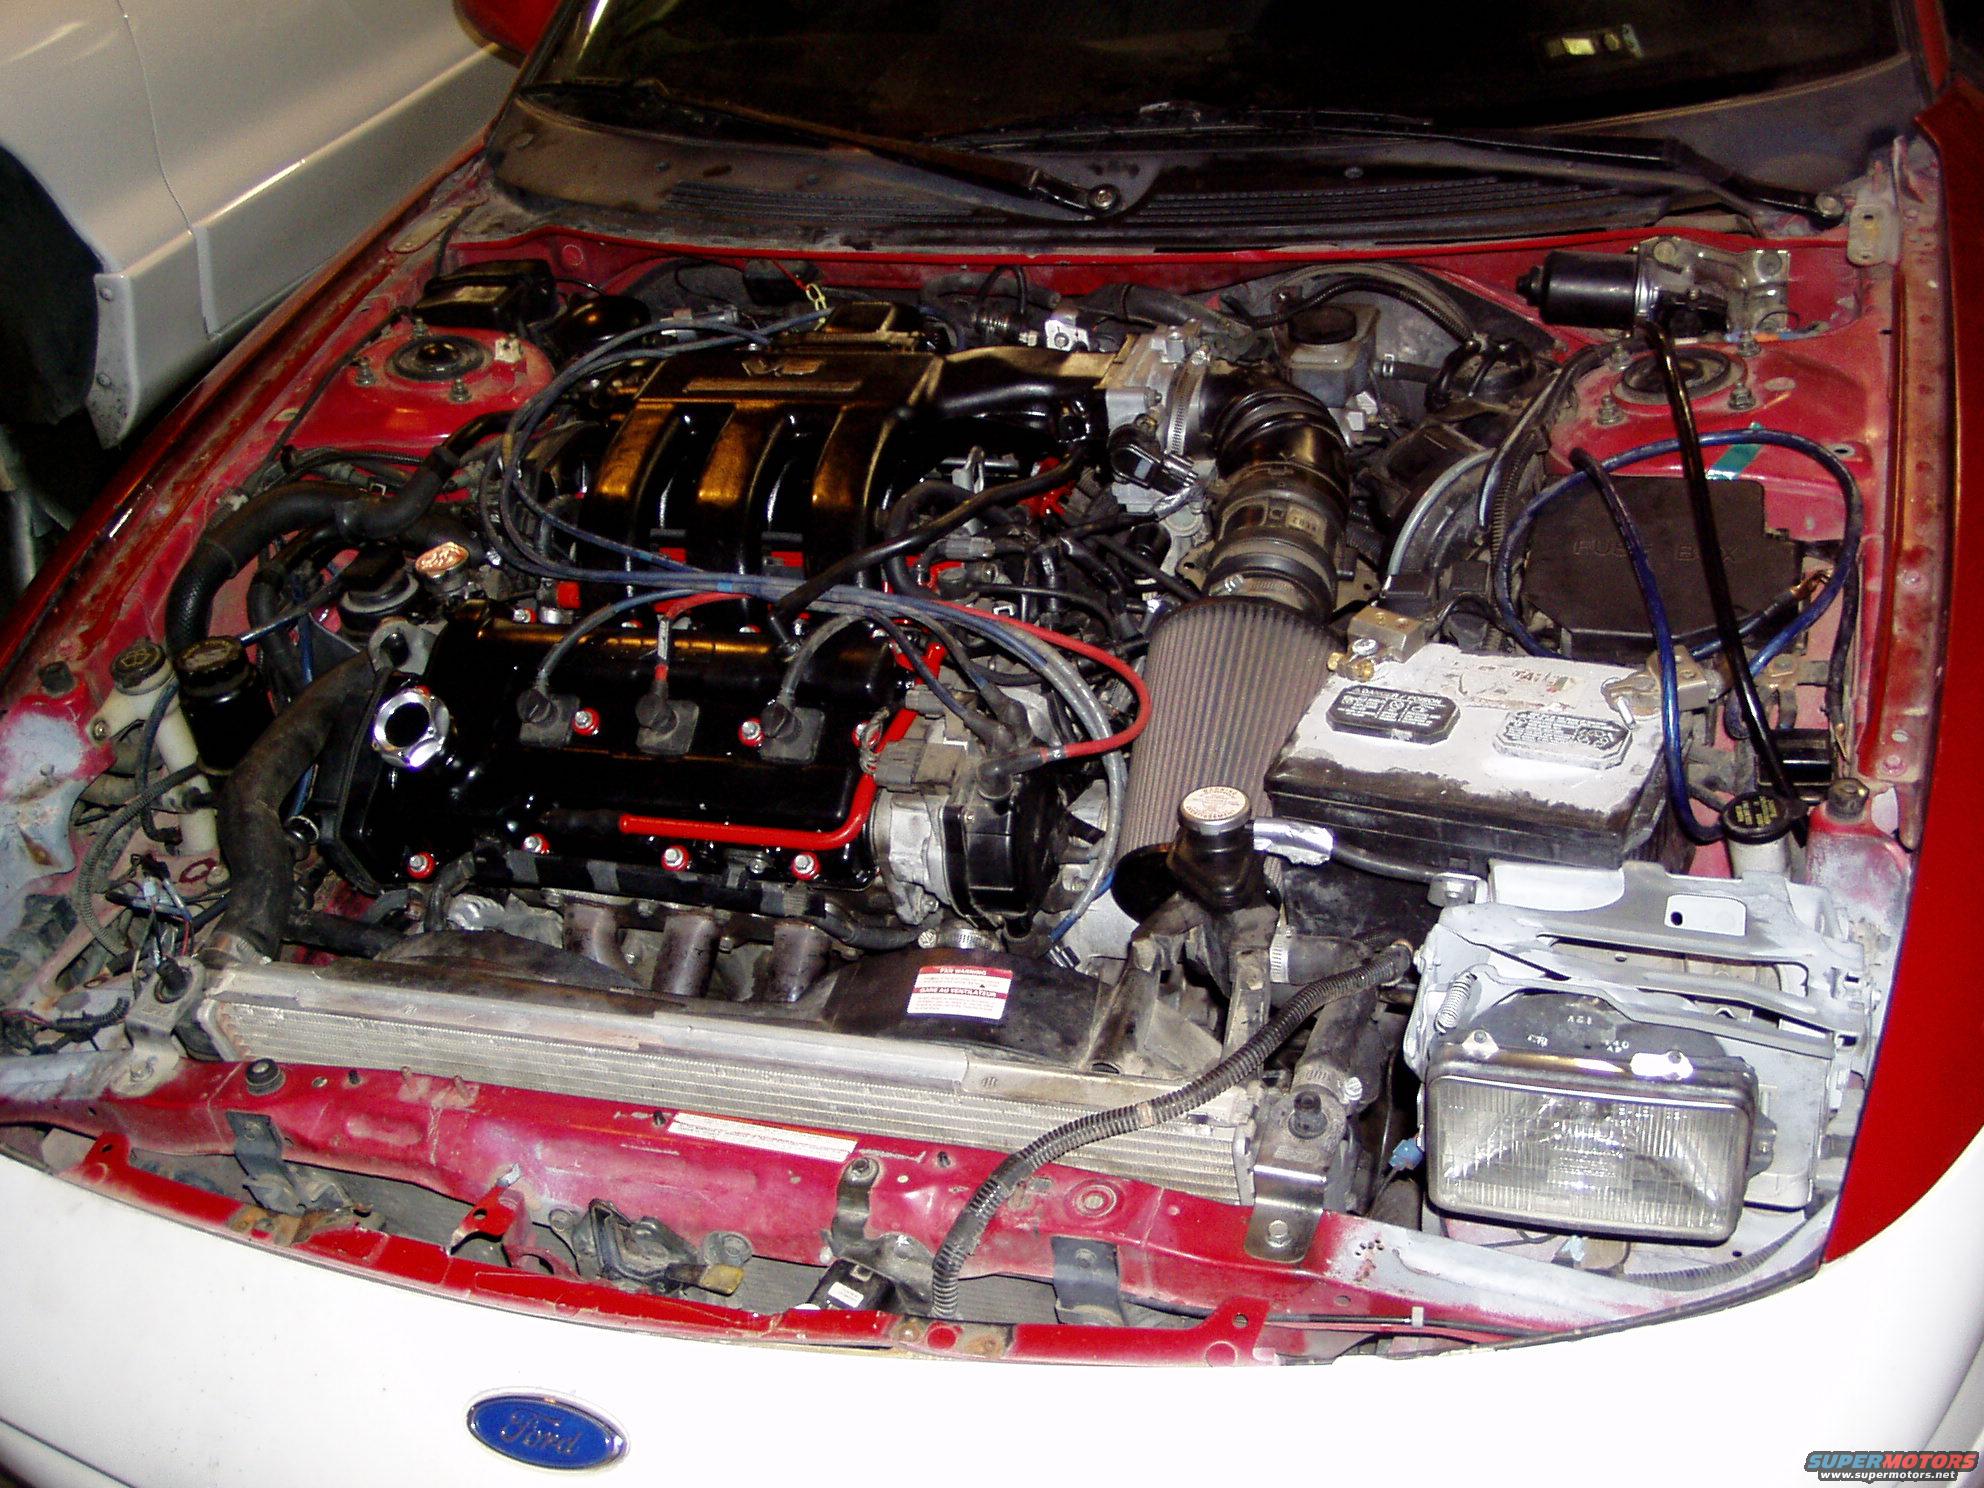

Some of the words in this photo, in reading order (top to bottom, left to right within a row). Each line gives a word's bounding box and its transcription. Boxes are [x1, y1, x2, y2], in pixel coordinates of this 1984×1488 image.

[1572, 539, 1653, 558] FUS
[1674, 543, 1740, 563] BX
[954, 968, 987, 976] WARNING
[500, 1407, 581, 1456] Ford
